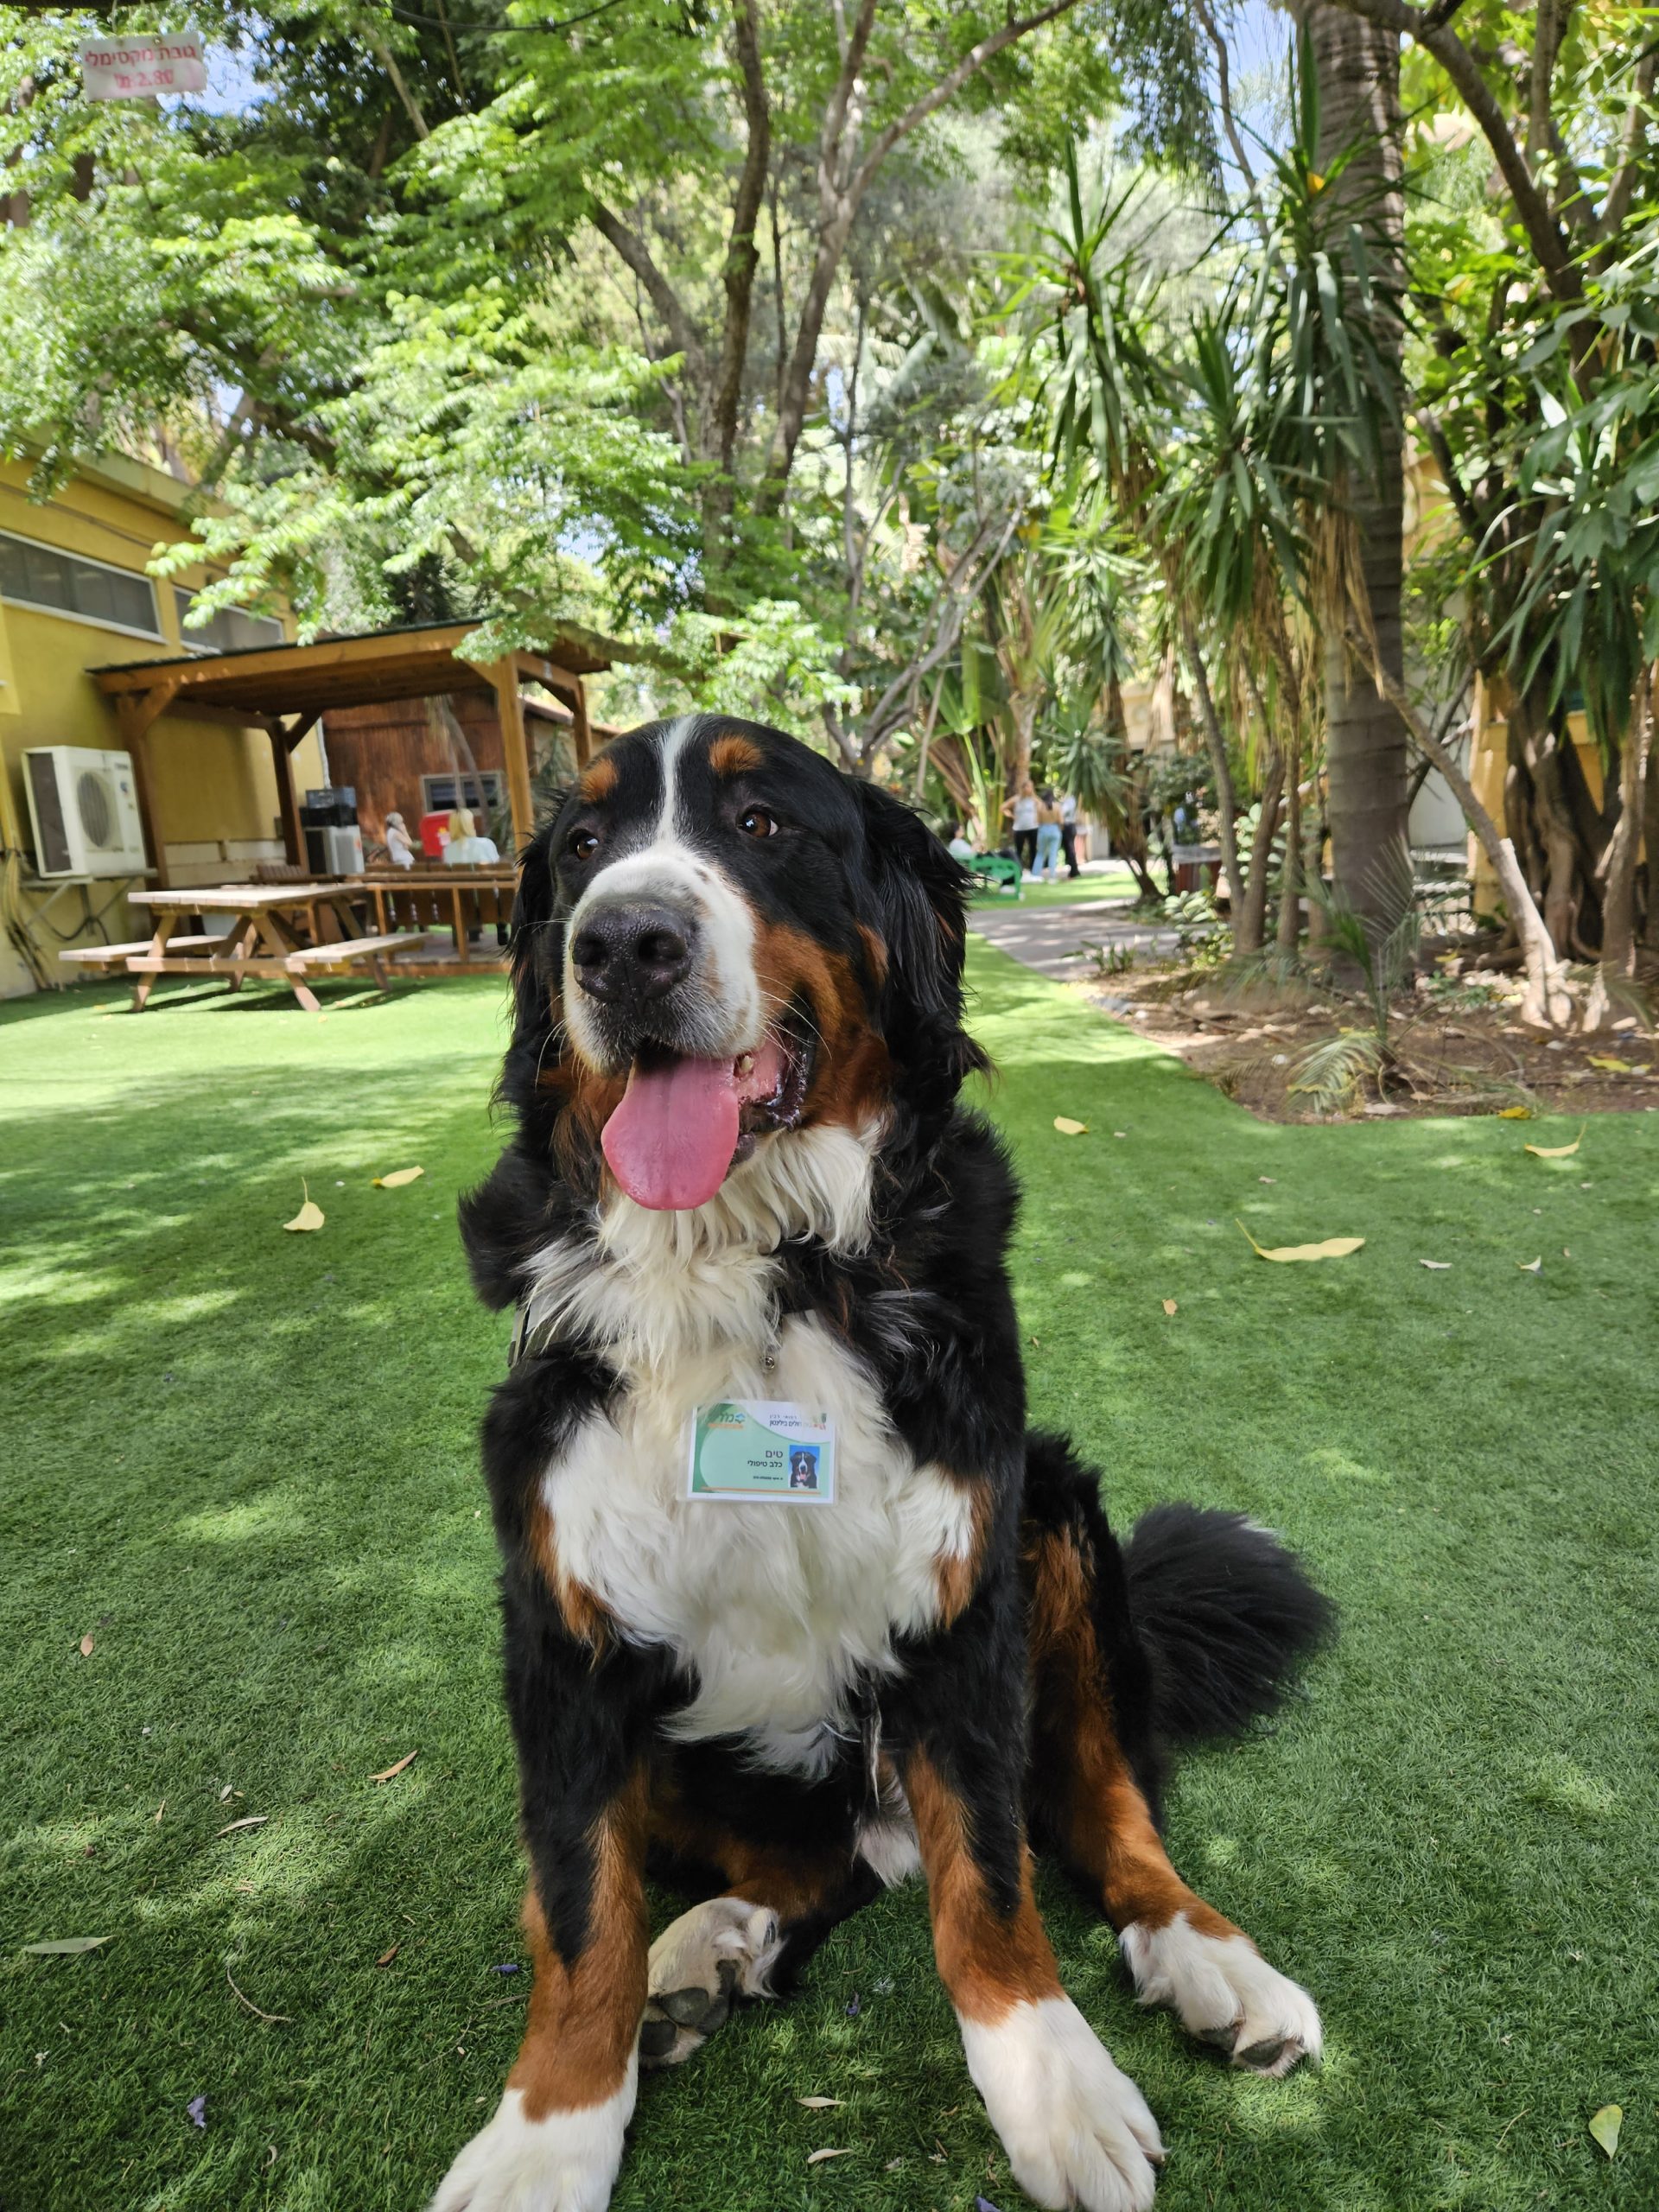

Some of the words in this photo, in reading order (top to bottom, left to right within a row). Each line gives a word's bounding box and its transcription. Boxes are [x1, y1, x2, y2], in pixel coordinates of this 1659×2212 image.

[85, 48, 154, 67] מקסימלי
[159, 44, 196, 60] גובה
[766, 1450, 783, 1459] טים
